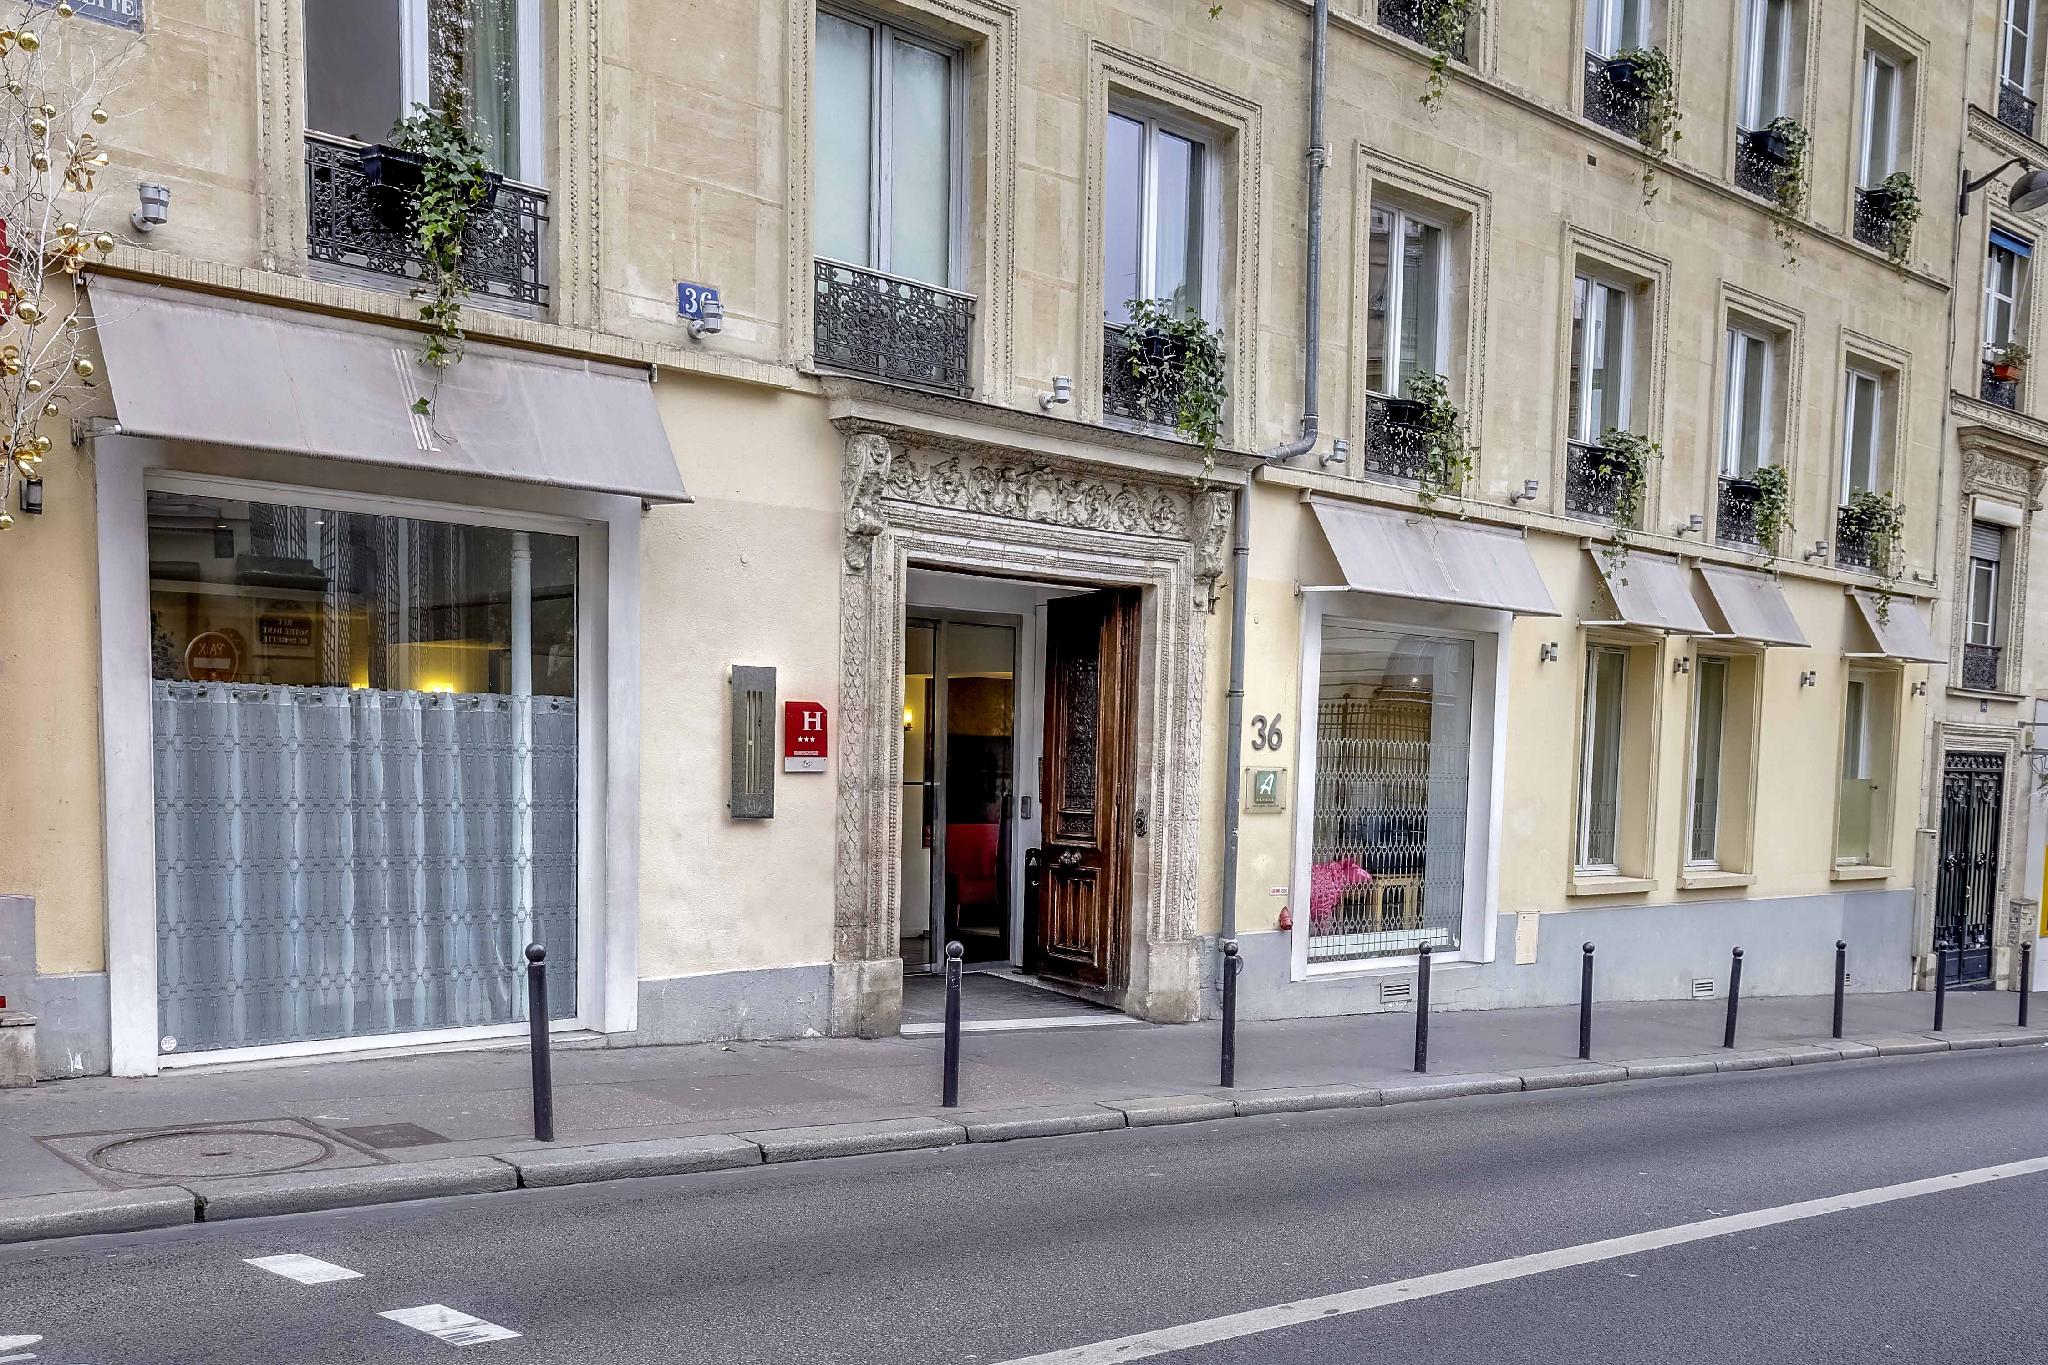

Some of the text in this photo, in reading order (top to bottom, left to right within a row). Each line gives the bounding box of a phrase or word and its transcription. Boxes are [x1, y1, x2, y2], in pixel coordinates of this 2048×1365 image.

[802, 711, 823, 731] H
[1251, 713, 1282, 751] 36
[1260, 773, 1275, 795] A
